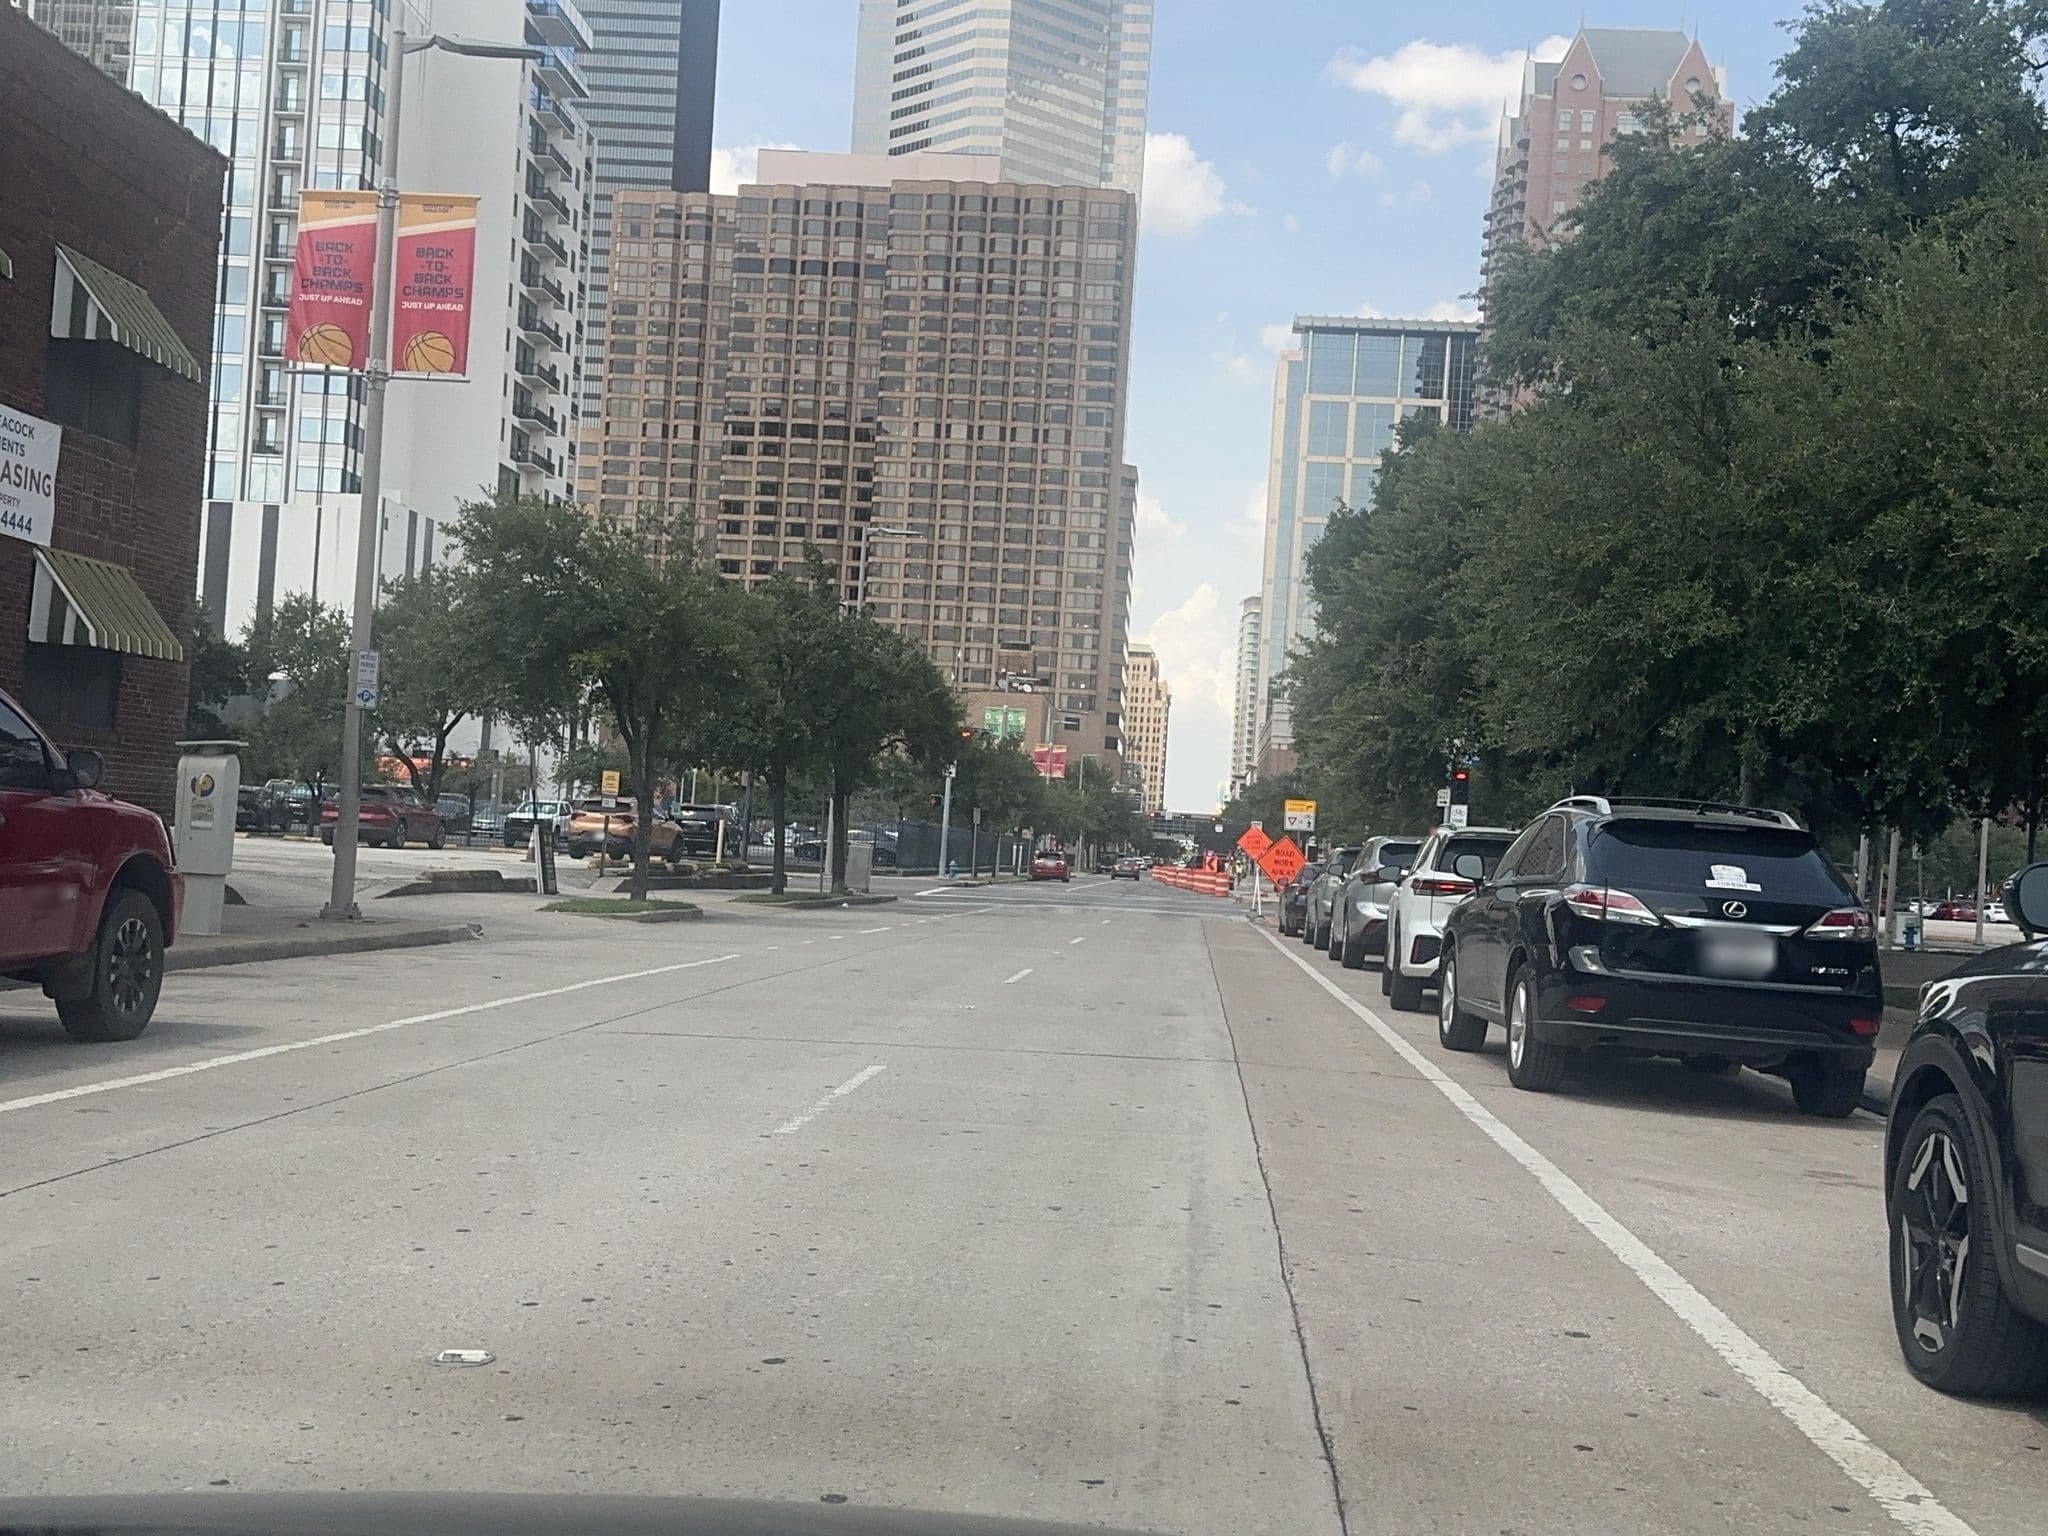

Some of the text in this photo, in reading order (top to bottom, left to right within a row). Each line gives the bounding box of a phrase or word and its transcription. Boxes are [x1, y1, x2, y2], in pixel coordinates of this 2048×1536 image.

[315, 241, 354, 253] BACK
[416, 247, 455, 259] BACK
[313, 266, 352, 279] BACK
[415, 273, 453, 284] BACK
[301, 278, 364, 293] CHAMPS
[403, 285, 465, 299] CHAMPS
[298, 293, 320, 301] JUST
[333, 296, 363, 305] AHEAD
[401, 301, 464, 311] JUST UP AHEAD
[0, 436, 25, 457] ENTS
[0, 510, 32, 535] 4444
